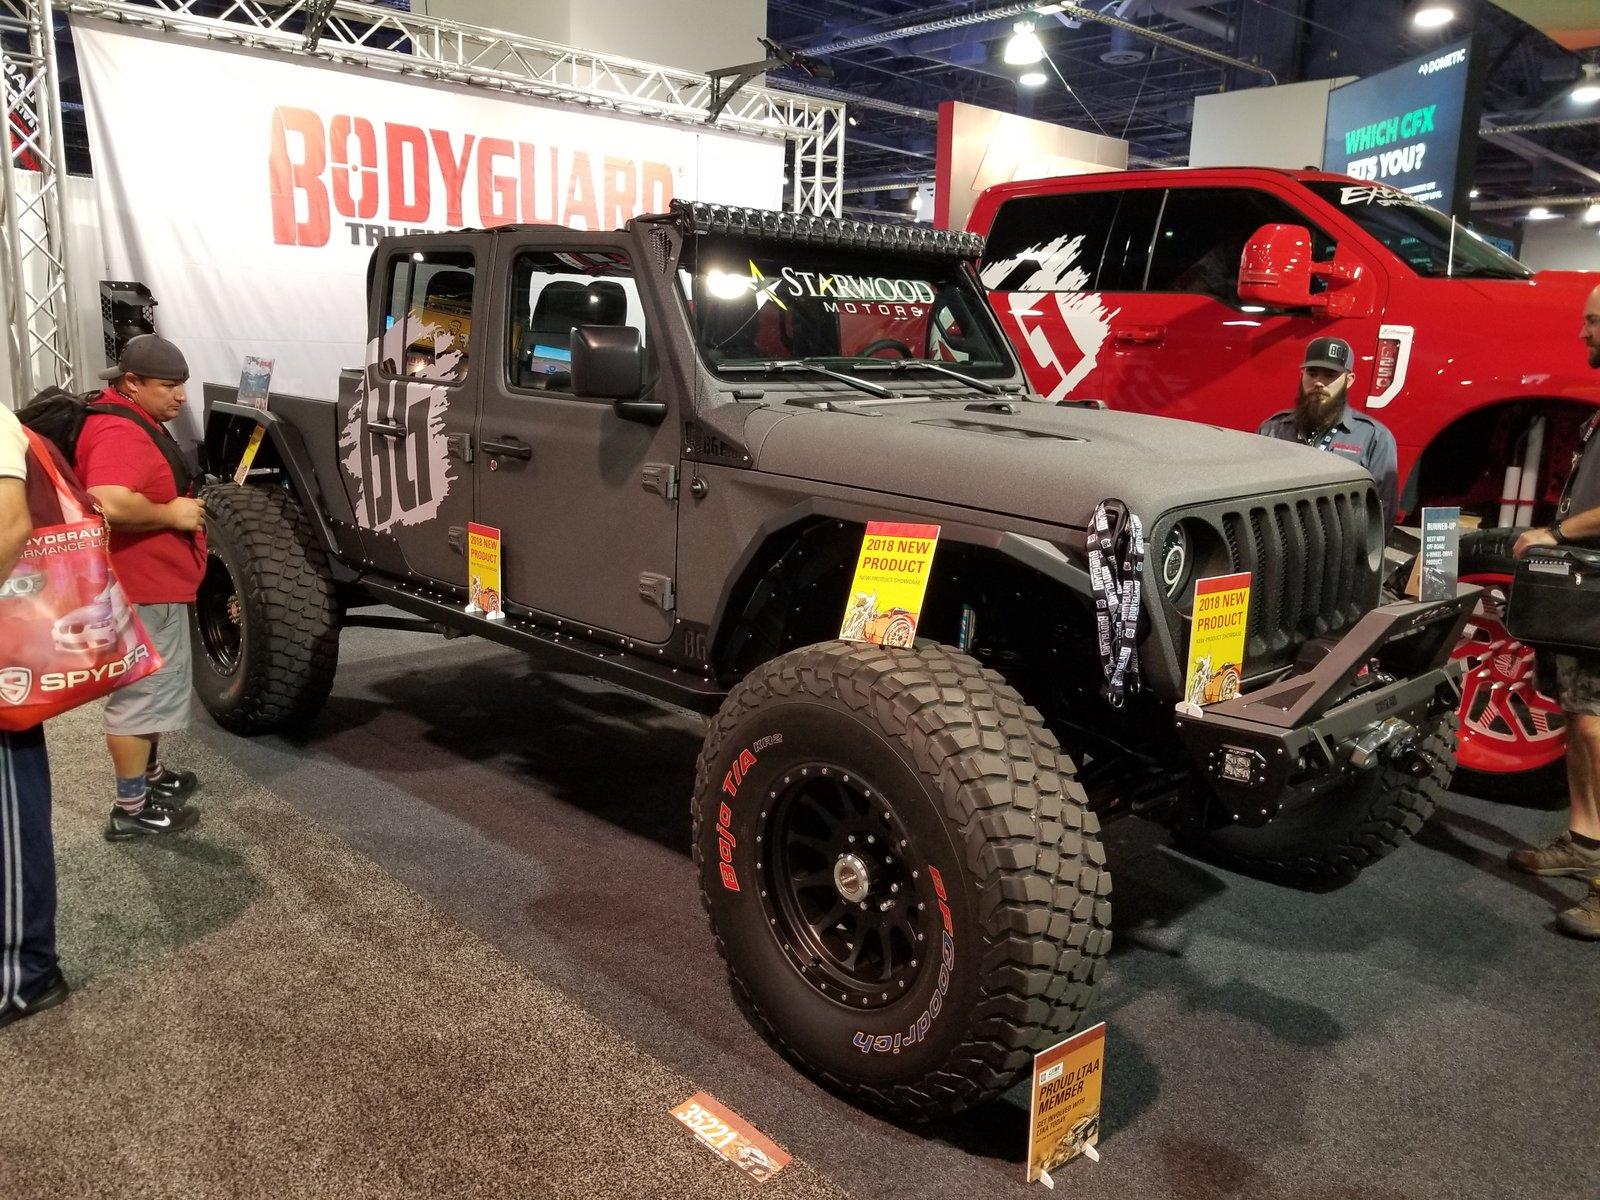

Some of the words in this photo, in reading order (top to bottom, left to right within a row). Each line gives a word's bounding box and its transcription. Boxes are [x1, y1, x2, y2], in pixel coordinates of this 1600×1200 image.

[1428, 48, 1467, 73] DOMETIC
[1345, 116, 1399, 155] WHICH
[1401, 104, 1437, 139] CFX
[1380, 142, 1426, 178] YOU?
[269, 105, 673, 248] BODYGUARD
[781, 266, 935, 304] STARWOOD
[823, 302, 925, 317] MOTORS
[1426, 522, 1457, 531] RUNNER-UP
[20, 541, 86, 559] RMANCE
[483, 537, 498, 551] NEW
[866, 539, 894, 552] 2018
[897, 540, 930, 554] NEW
[470, 548, 497, 564] PRODUCT
[863, 556, 925, 573] PRODUCT
[1199, 596, 1220, 612] 2018
[1222, 591, 1246, 608] NEW
[1197, 611, 1243, 632] PRODUCT
[40, 643, 149, 692] SPYDER
[715, 801, 741, 891] Baja
[852, 864, 955, 1055] BFGoodrich
[1039, 1071, 1075, 1101] PROUD
[1076, 1058, 1100, 1081] LTAA
[1038, 1080, 1084, 1116] MEMBER
[1048, 1104, 1072, 1123] INVOLVED
